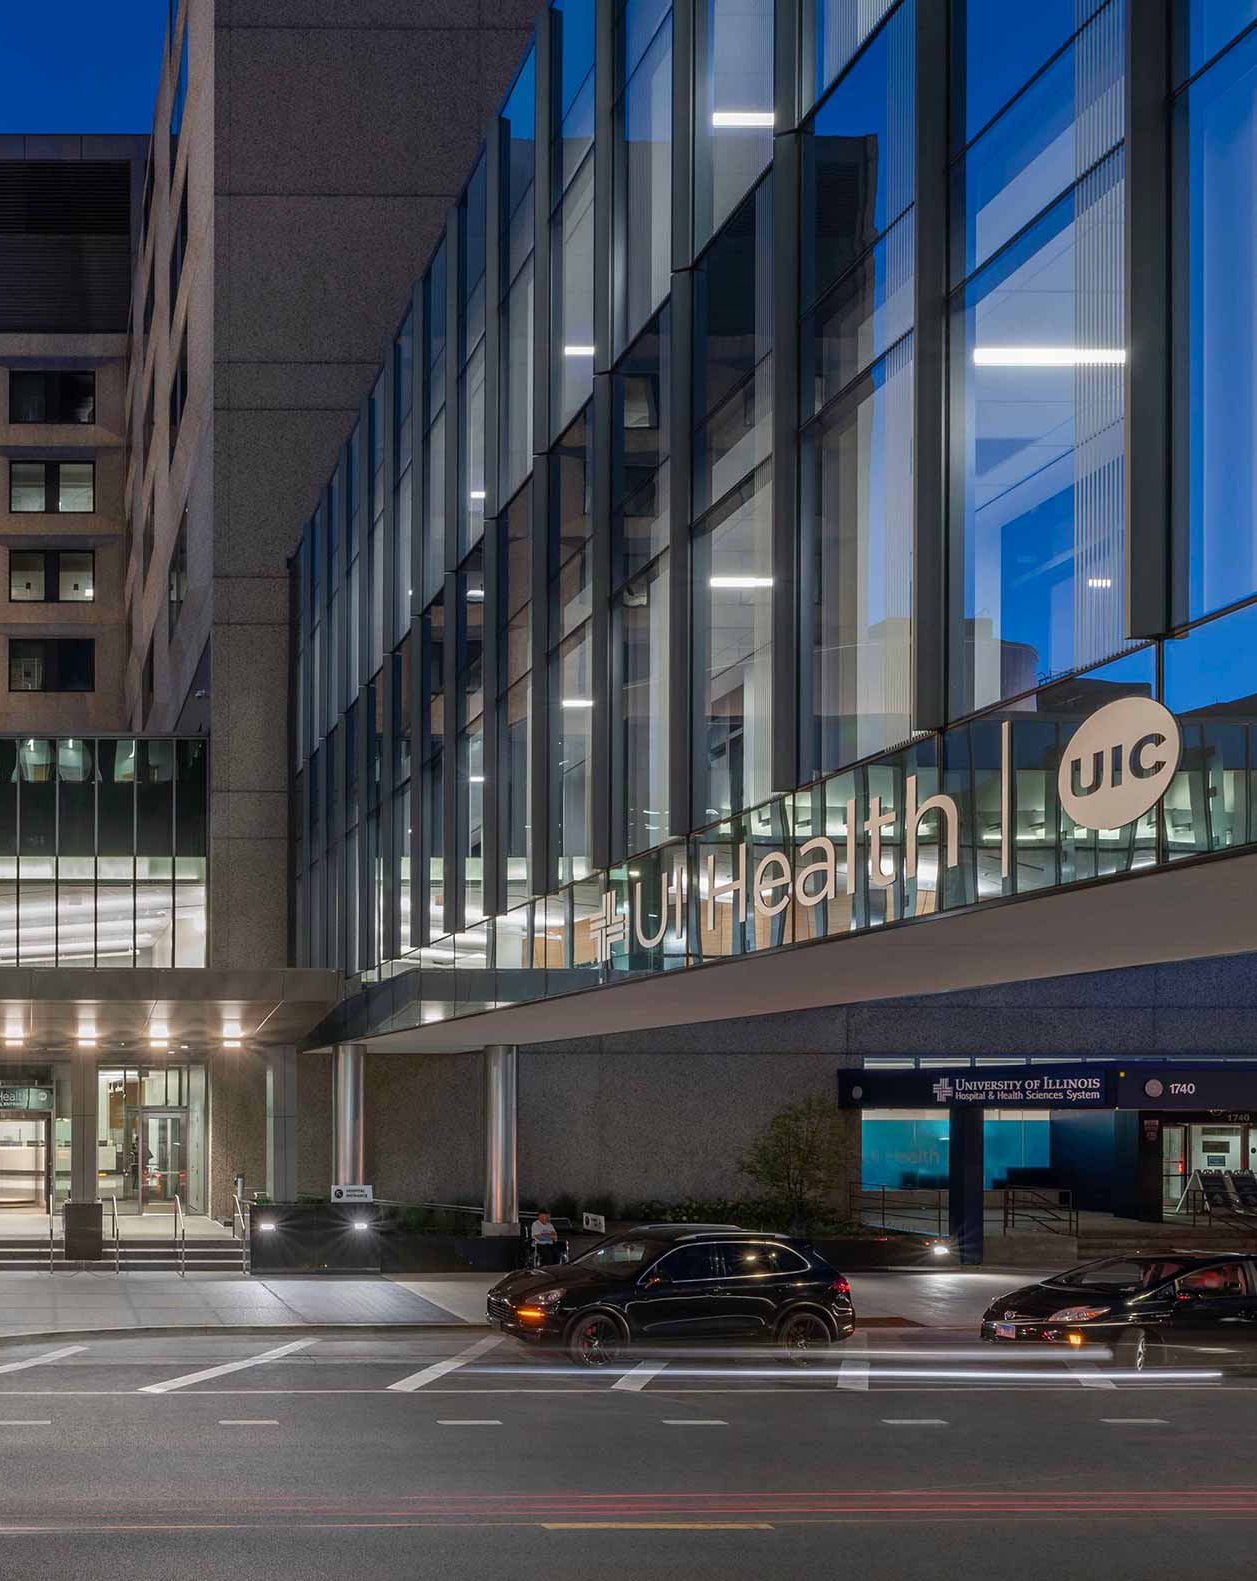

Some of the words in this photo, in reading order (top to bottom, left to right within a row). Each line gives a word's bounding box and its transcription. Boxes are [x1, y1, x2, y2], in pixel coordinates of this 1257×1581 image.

[1070, 733, 1167, 798] UIC
[635, 864, 683, 948] UI
[707, 774, 960, 931] Health
[955, 1078, 1022, 1091] UNIVERSITY
[1024, 1080, 1041, 1090] OF
[1043, 1076, 1101, 1089] ILLINOIS
[1169, 1083, 1196, 1094] 1740
[955, 1091, 985, 1101] Hospital
[988, 1091, 994, 1100] &
[997, 1090, 1023, 1100] Health
[1026, 1090, 1063, 1100] Sciences
[1066, 1090, 1100, 1101] System
[1228, 1114, 1250, 1122] 1740
